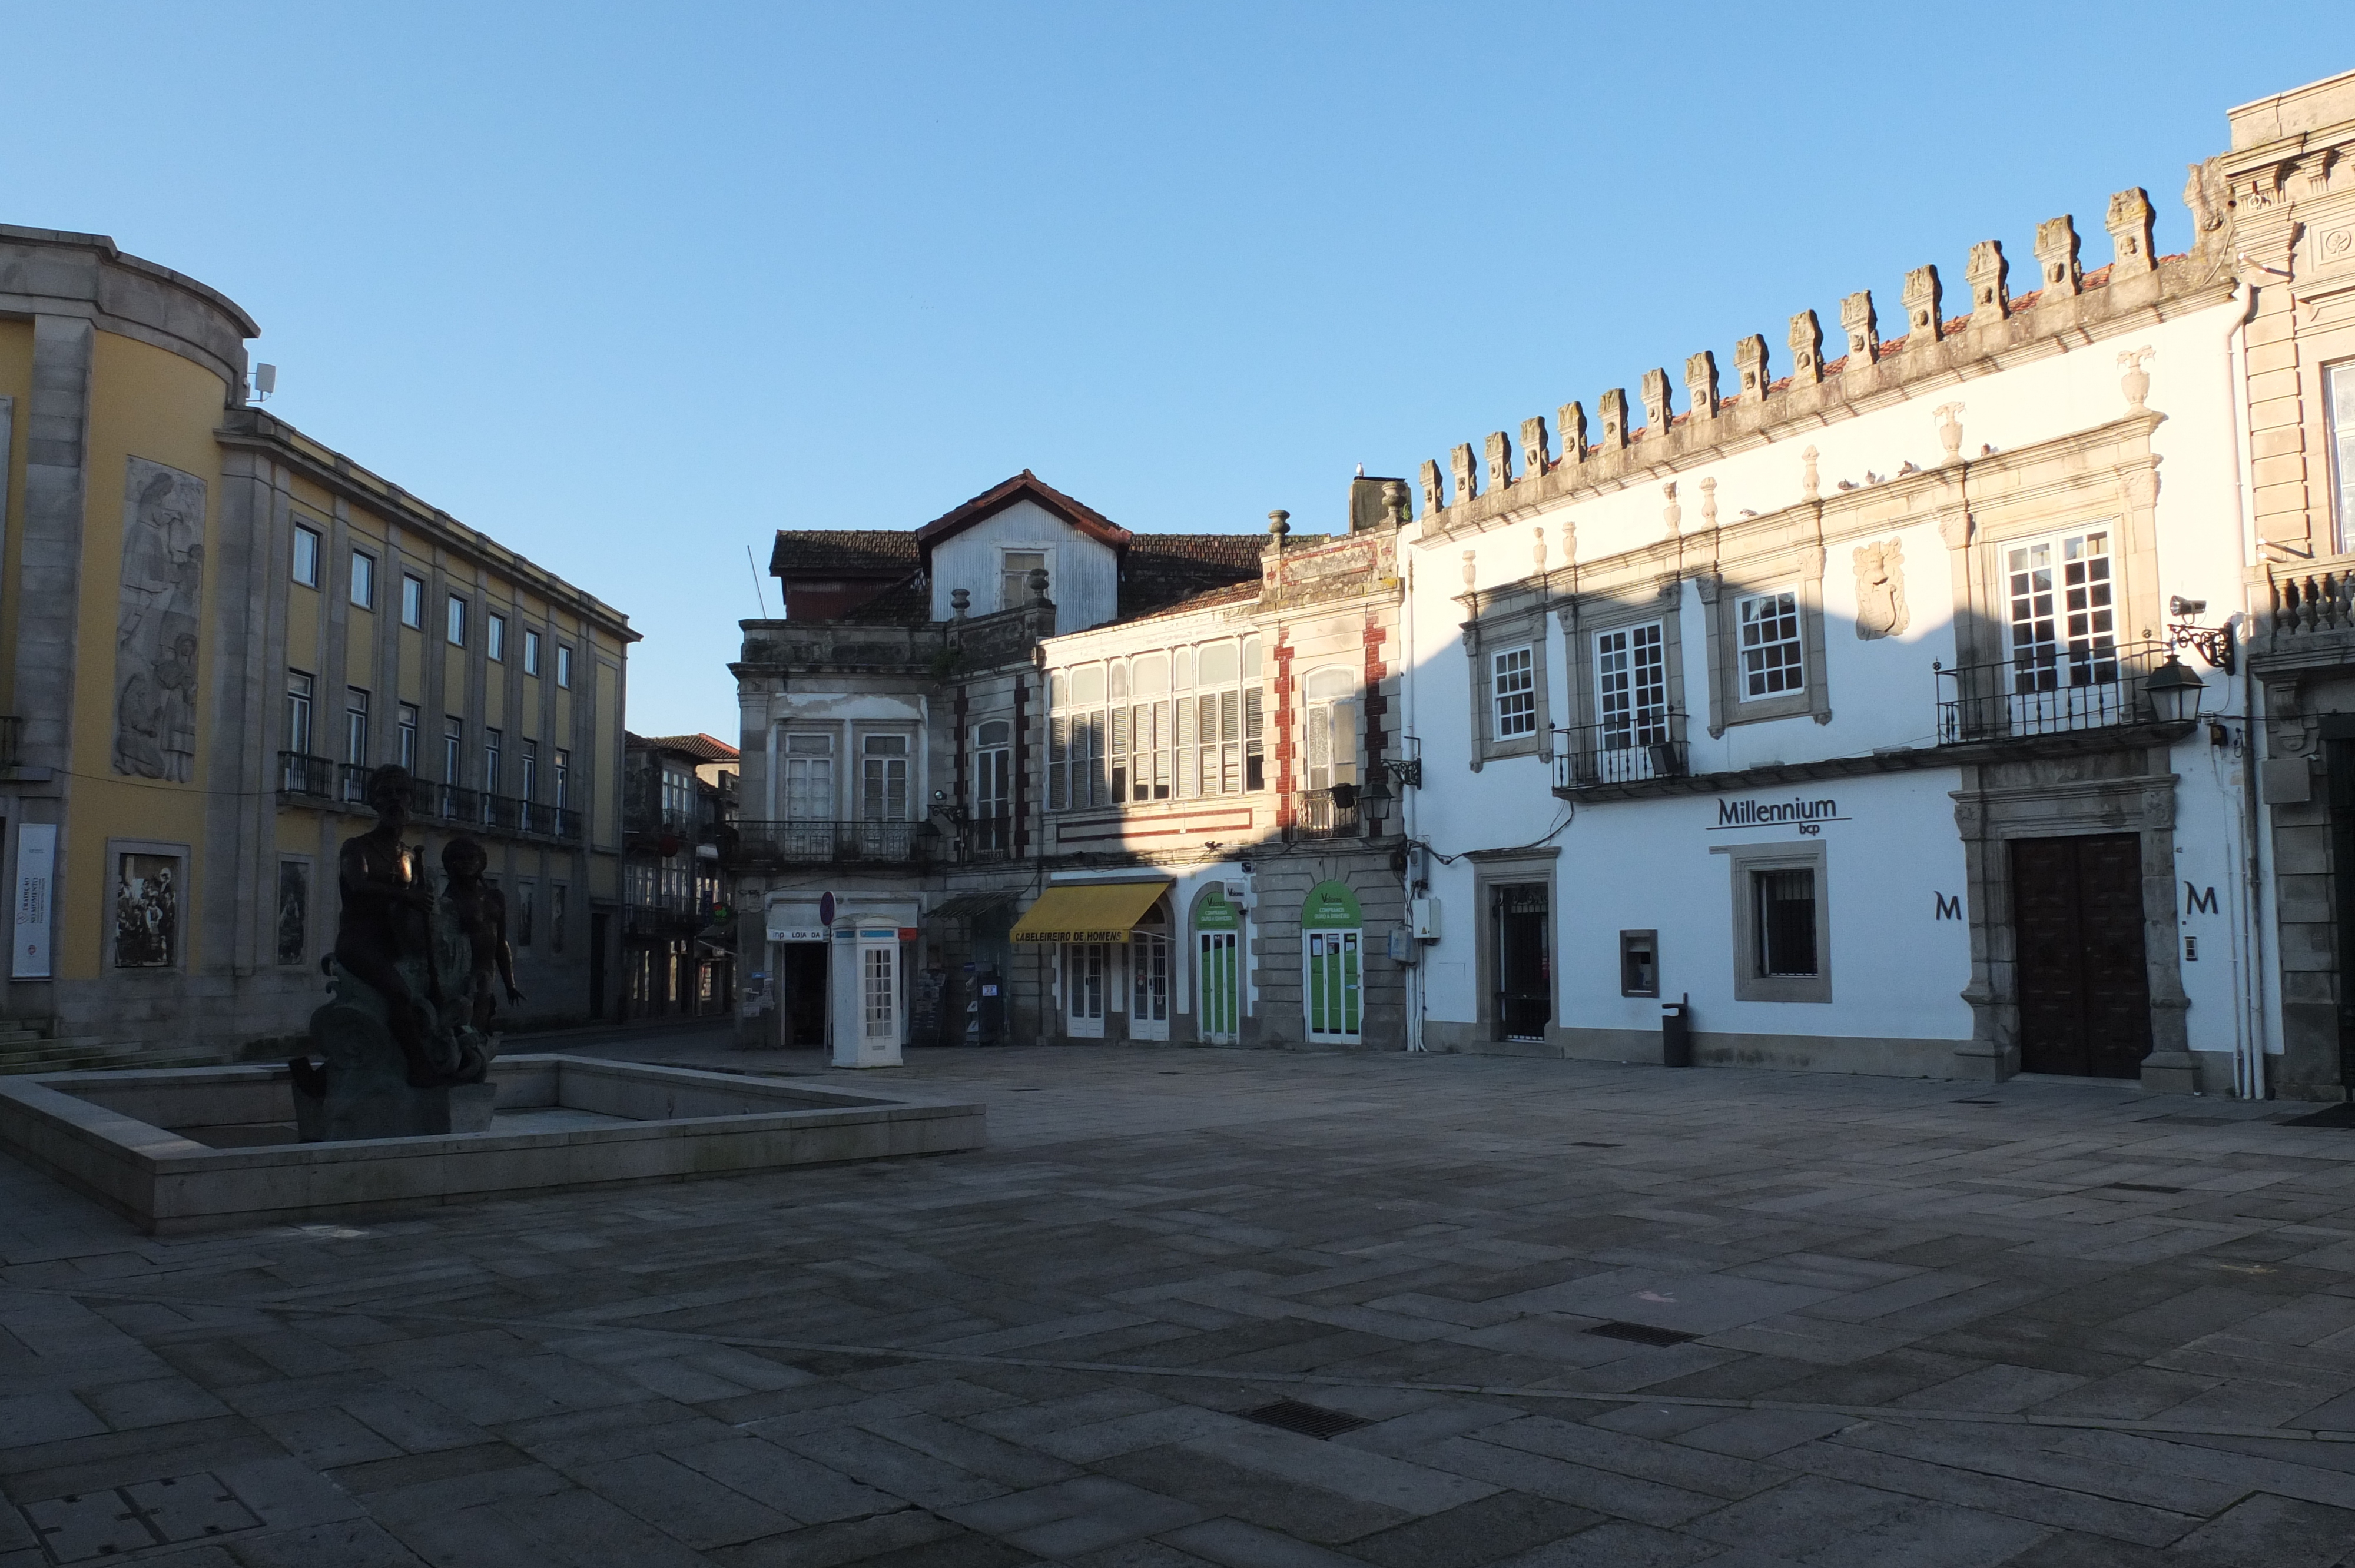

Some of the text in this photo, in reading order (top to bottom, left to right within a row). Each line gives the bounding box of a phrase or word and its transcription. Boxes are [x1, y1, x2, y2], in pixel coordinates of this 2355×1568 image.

[1718, 797, 1837, 825] Millennium
[1799, 823, 1820, 836] bcp
[1933, 890, 1962, 921] M
[2184, 881, 2219, 915] M
[1016, 931, 1122, 942] CABELEIREIRO DE HOMENS
